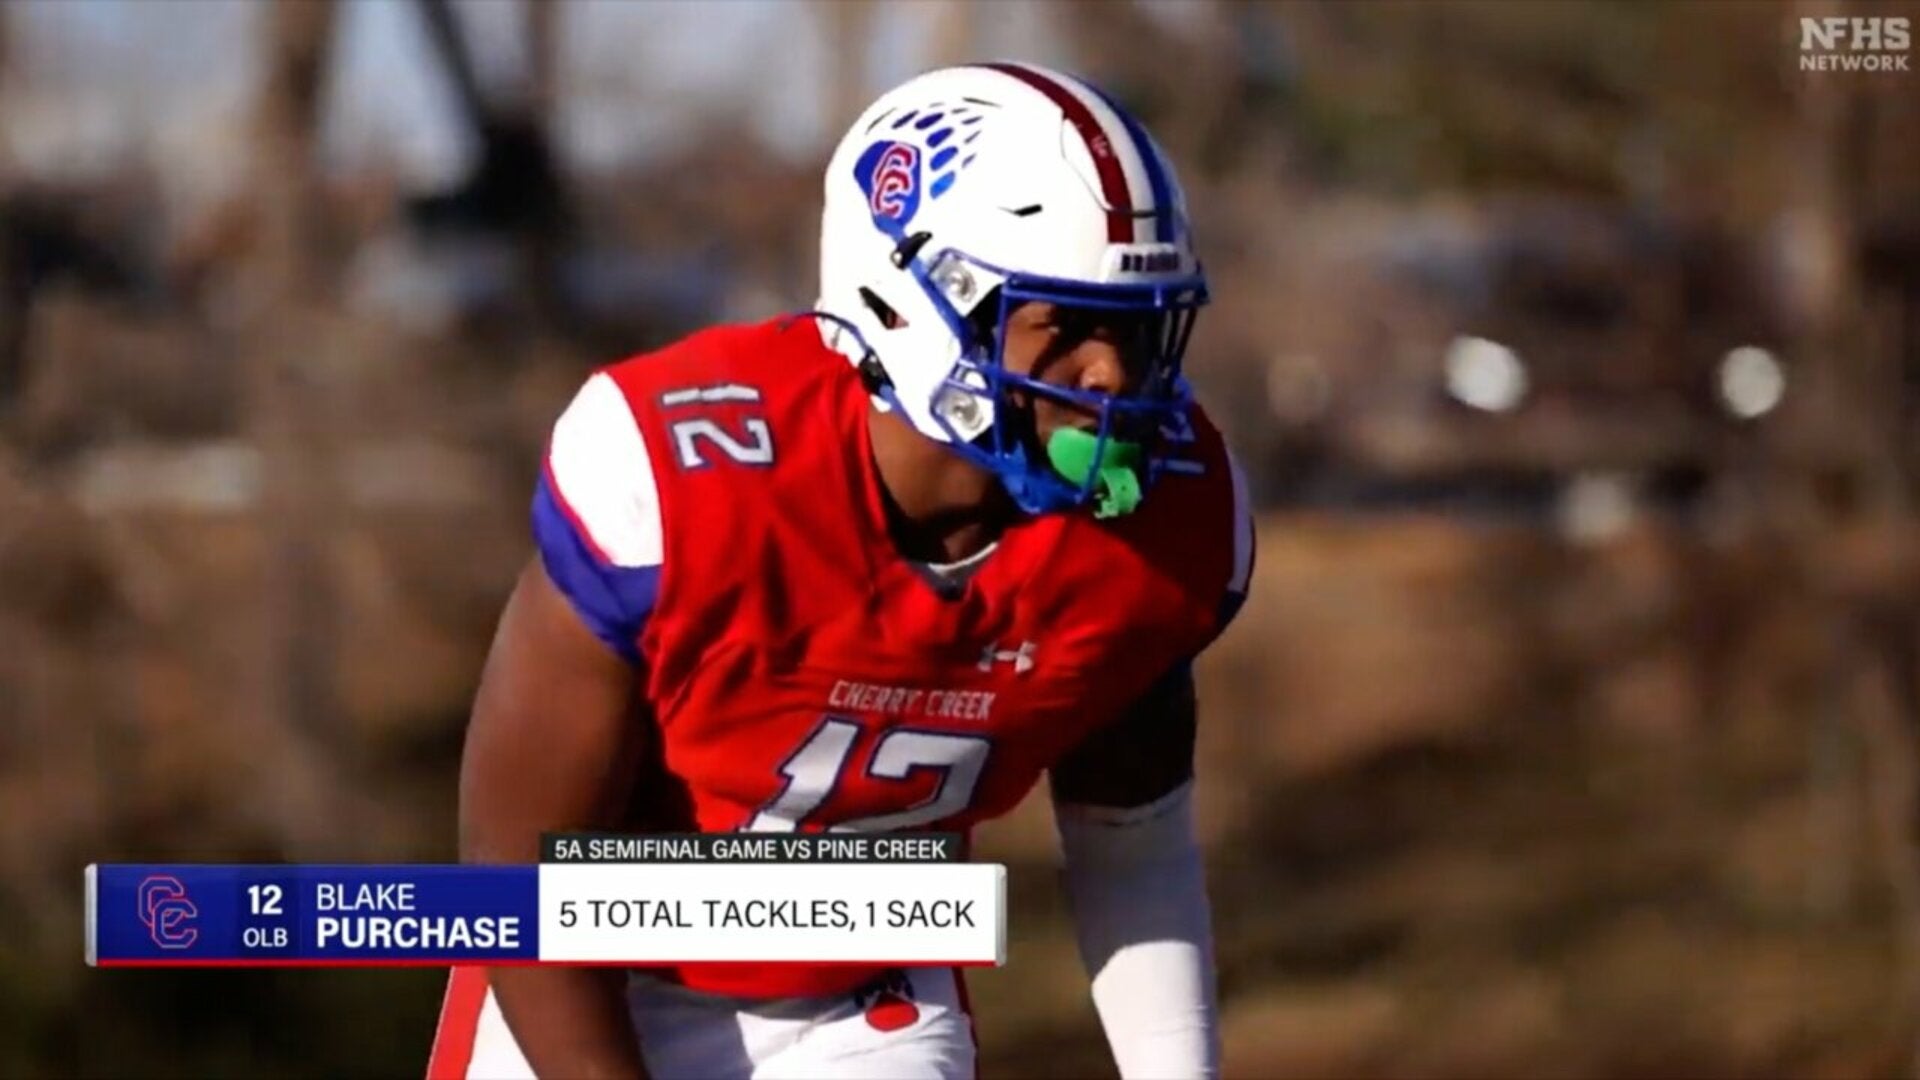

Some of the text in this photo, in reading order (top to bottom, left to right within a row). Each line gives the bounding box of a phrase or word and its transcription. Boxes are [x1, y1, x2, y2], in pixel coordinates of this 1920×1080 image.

[661, 383, 774, 468] 12
[829, 679, 996, 720] CHERRY CREEK
[742, 717, 992, 832] 12
